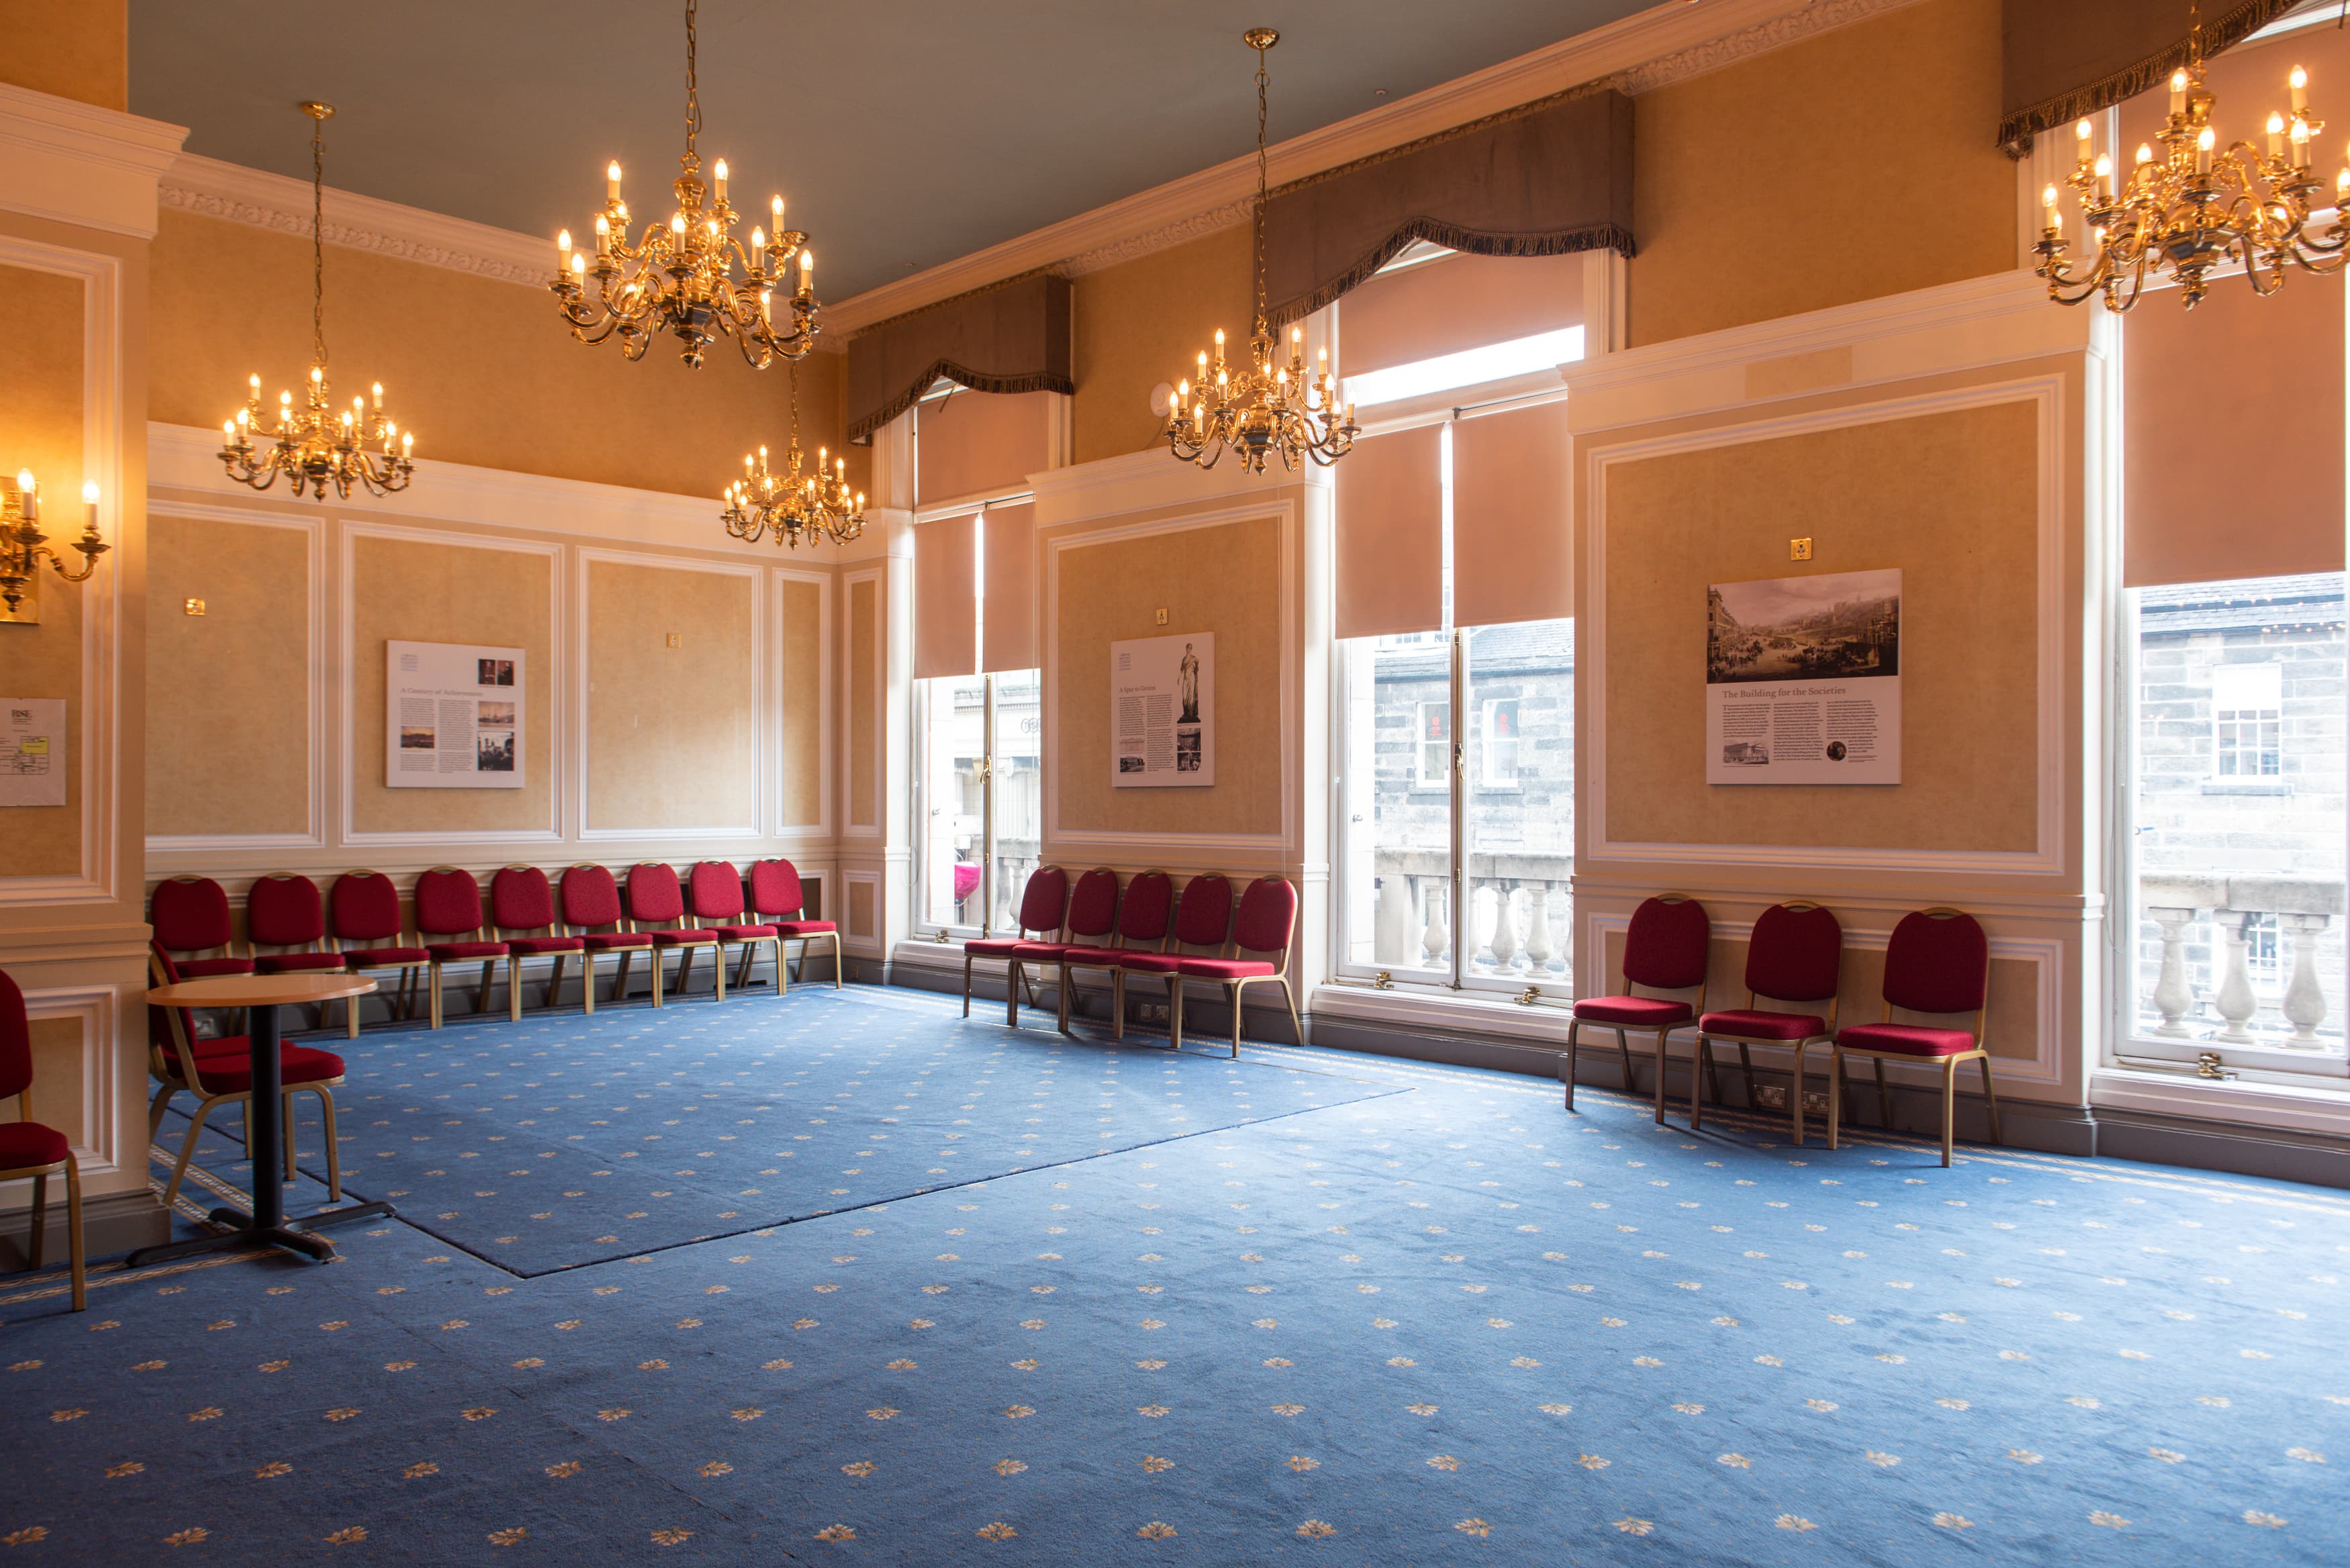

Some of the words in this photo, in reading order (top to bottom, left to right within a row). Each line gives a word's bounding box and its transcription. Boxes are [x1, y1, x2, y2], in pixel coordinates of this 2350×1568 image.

[1722, 690, 1738, 699] The
[1740, 689, 1777, 699] Building
[1778, 688, 1791, 697] for
[1792, 687, 1806, 696] the
[1808, 686, 1846, 695] Societies
